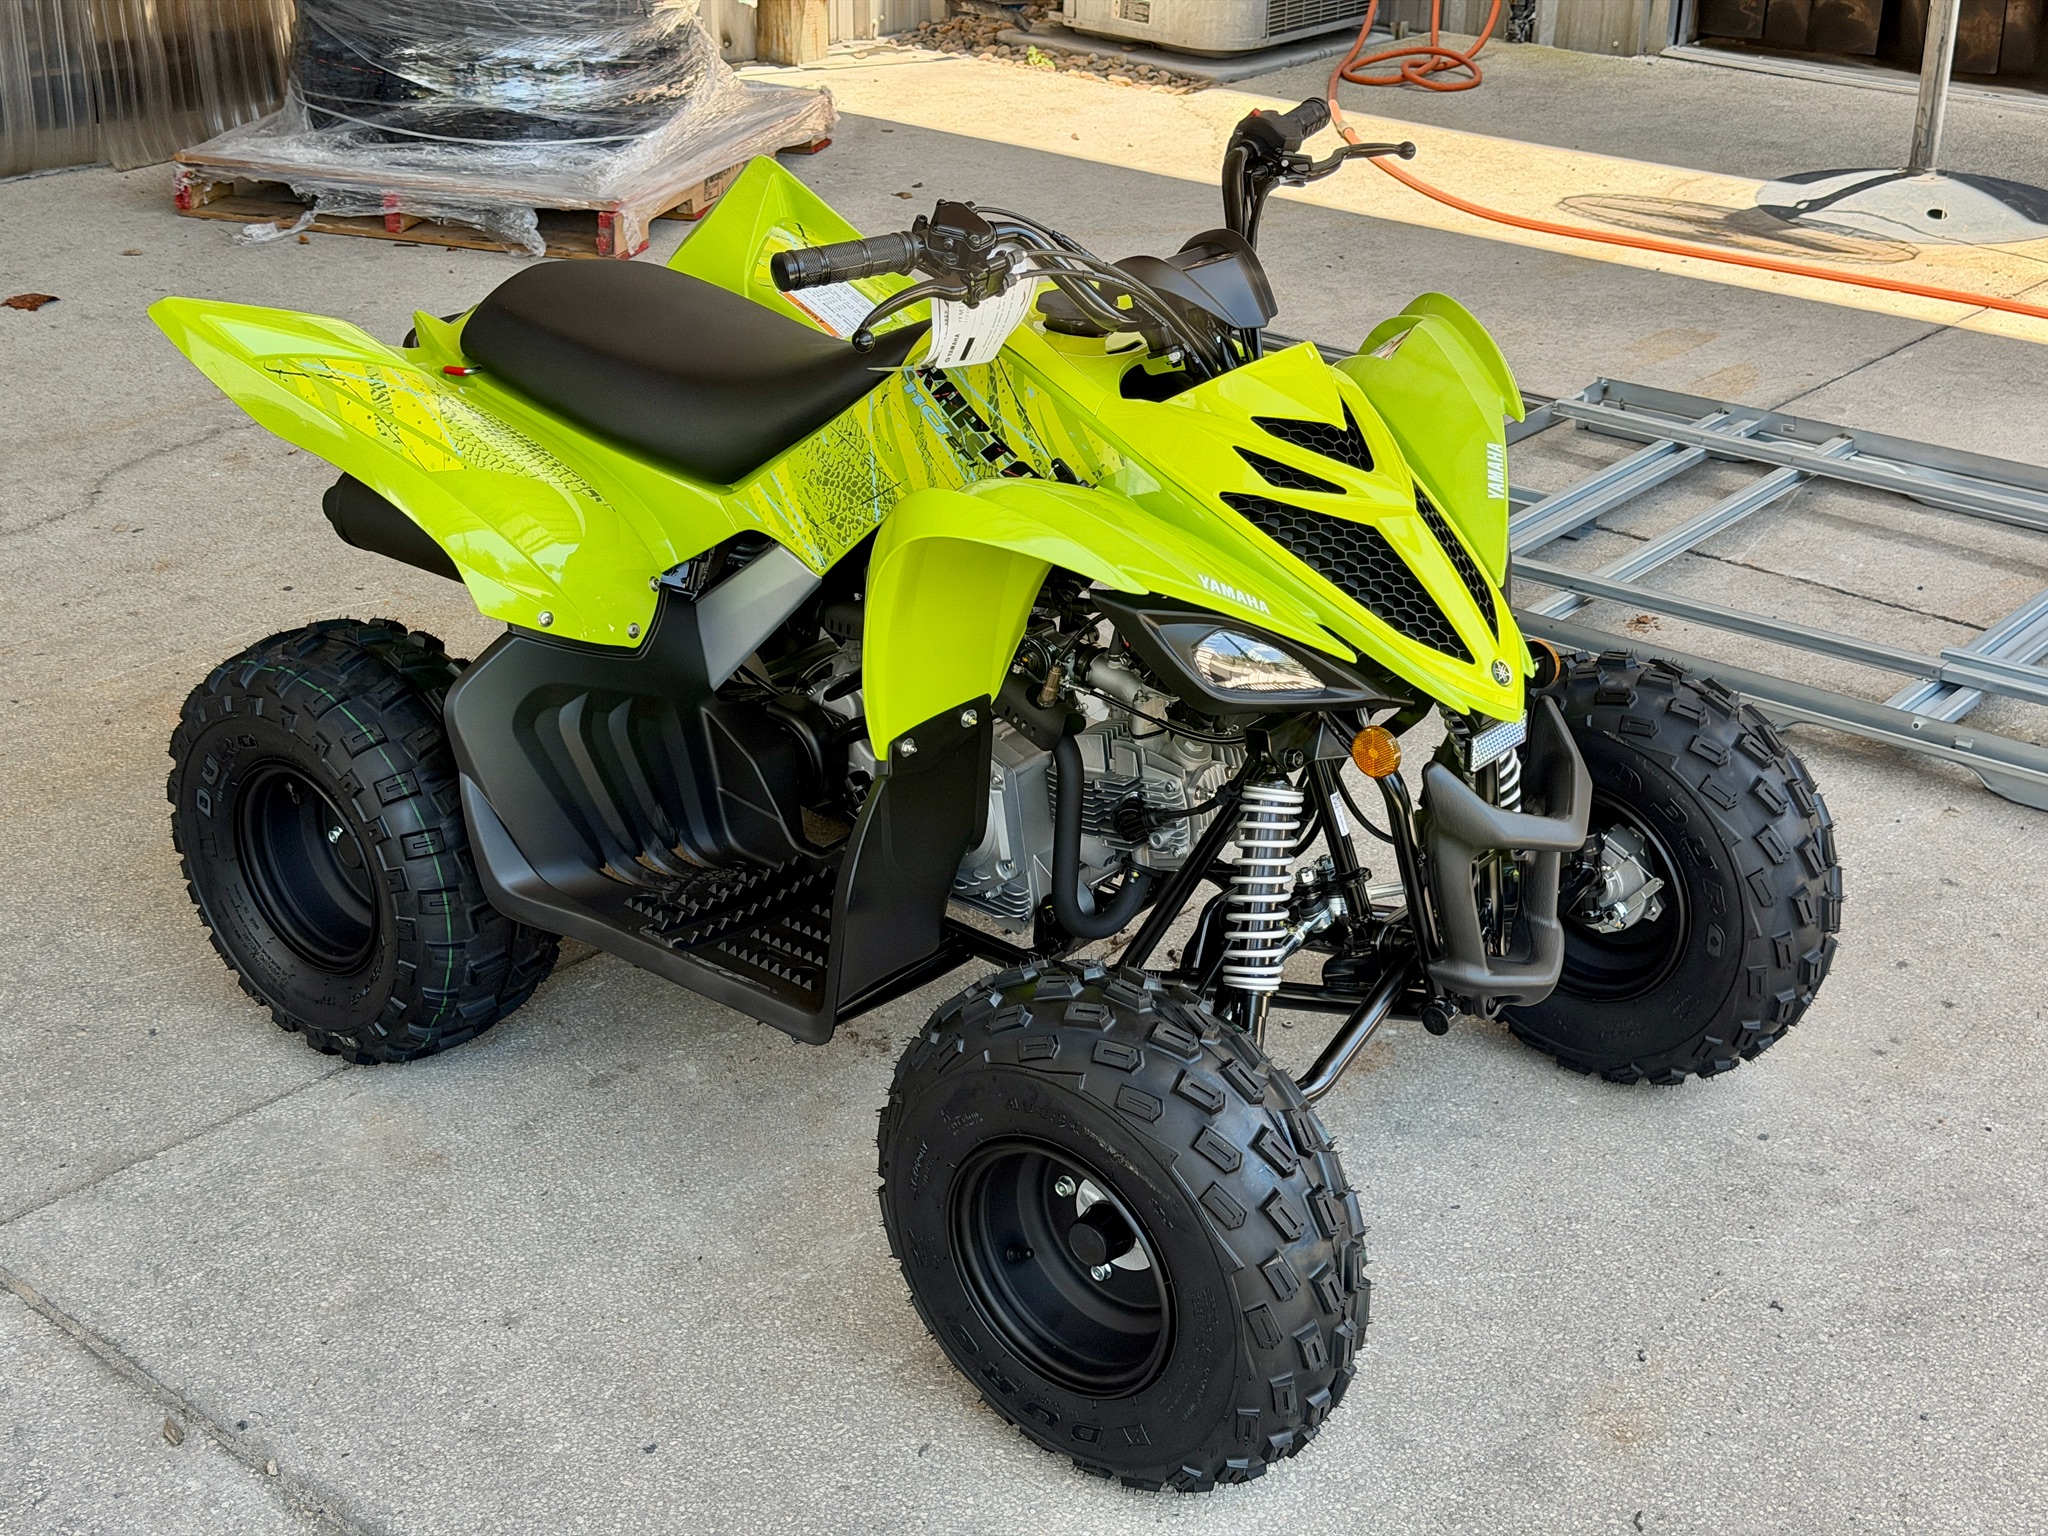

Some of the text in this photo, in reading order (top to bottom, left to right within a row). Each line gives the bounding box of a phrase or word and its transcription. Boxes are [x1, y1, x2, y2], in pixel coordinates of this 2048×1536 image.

[947, 333, 960, 357] YAMAHA
[903, 382, 979, 467] 110 EFI
[914, 366, 1045, 479] RAPTO
[1486, 442, 1505, 500] YAMAHA
[1197, 573, 1271, 616] YAMAHA
